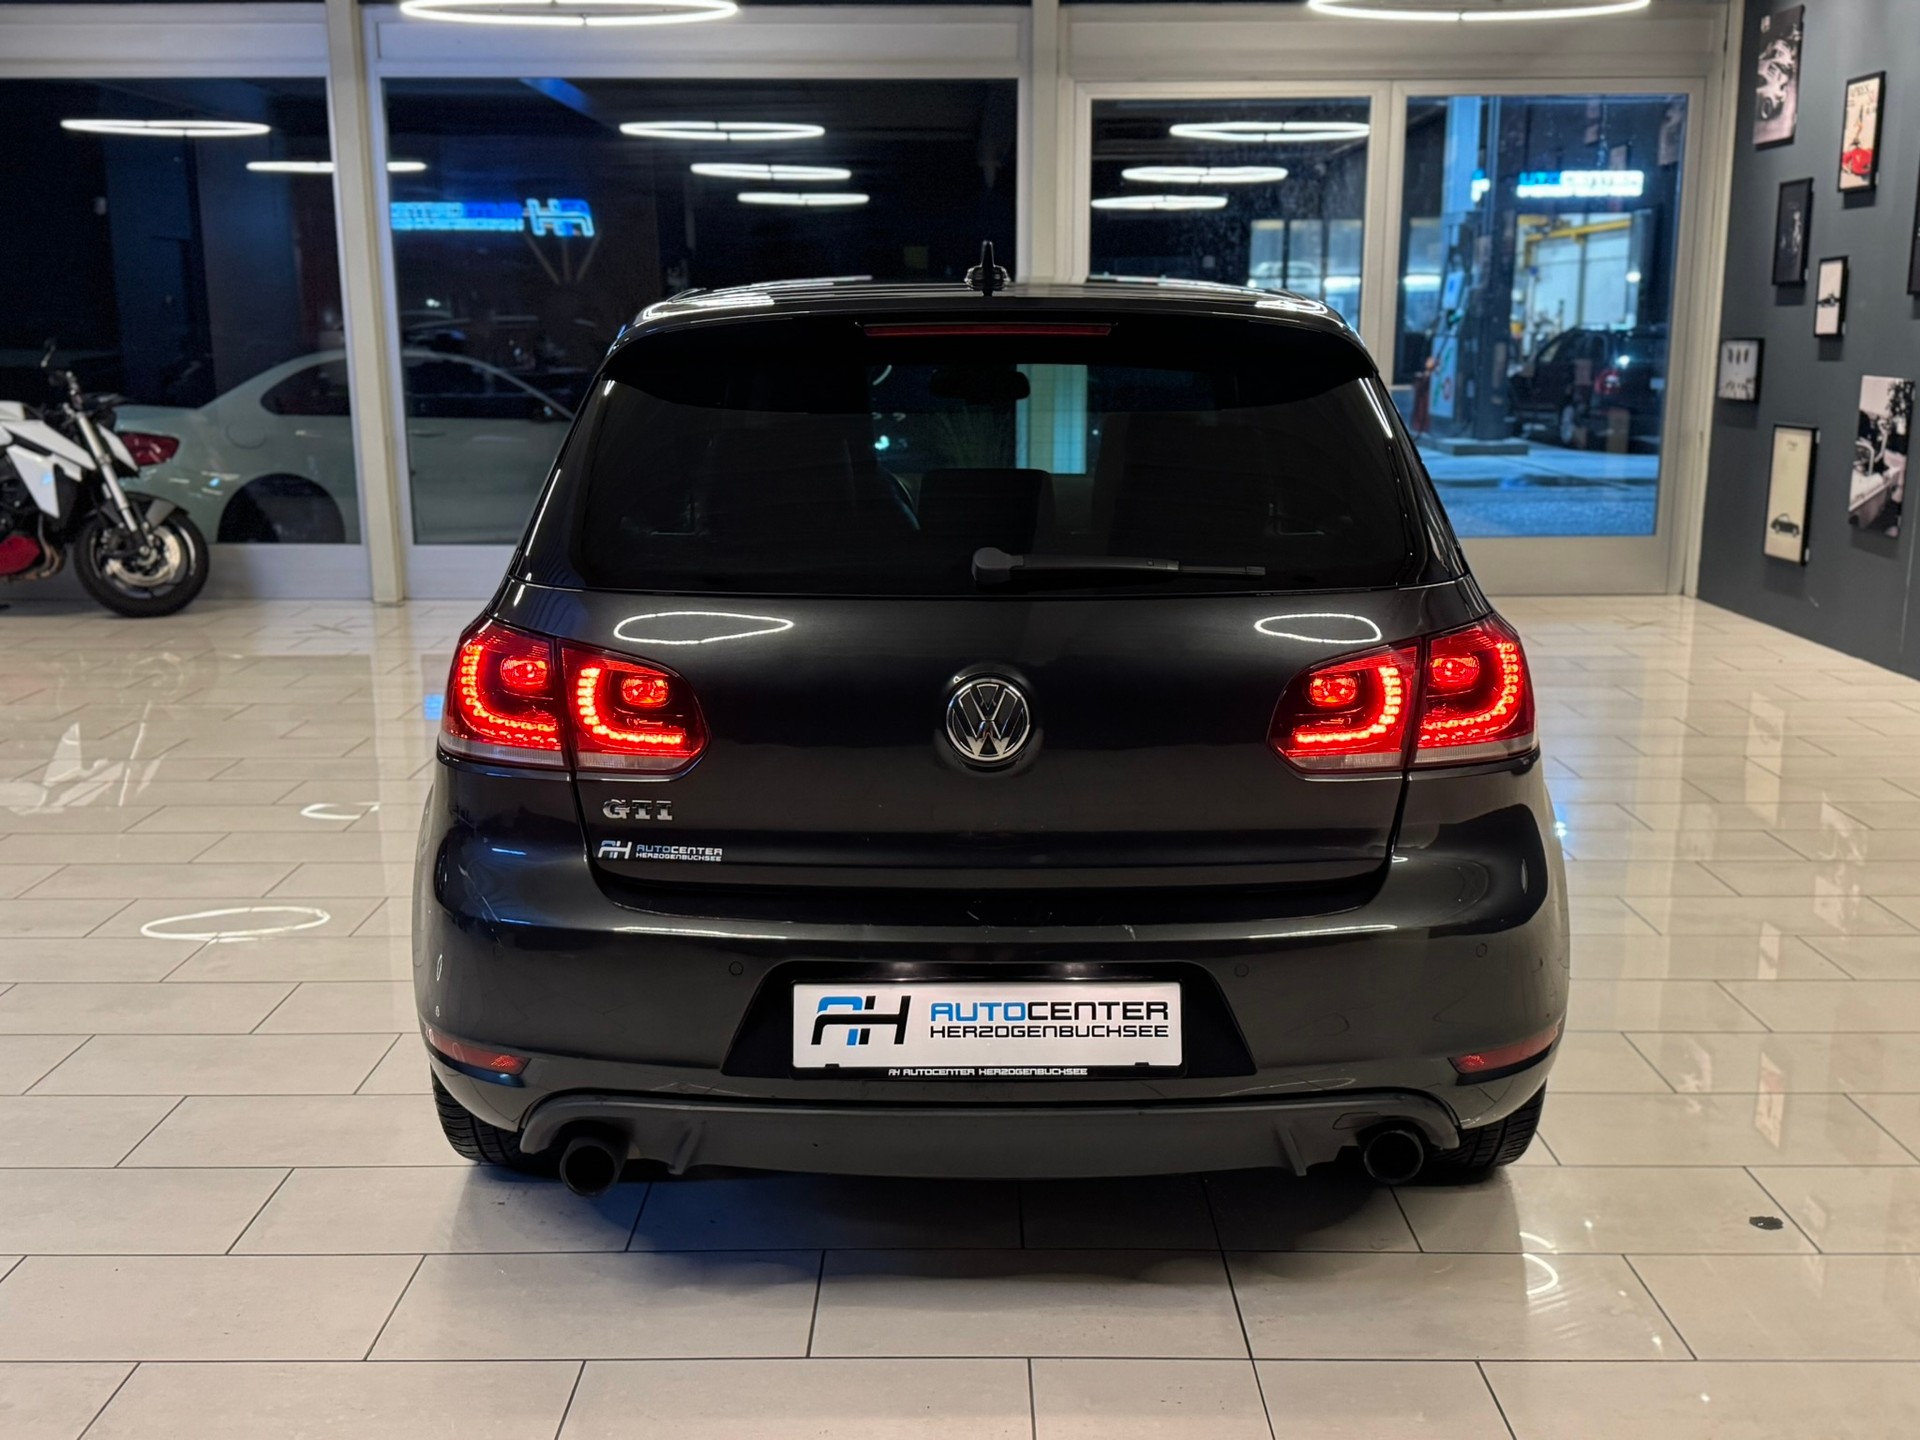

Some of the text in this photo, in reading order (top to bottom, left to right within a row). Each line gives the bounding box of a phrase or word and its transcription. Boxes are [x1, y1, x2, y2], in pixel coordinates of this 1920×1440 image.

[949, 681, 1026, 760] VW
[602, 799, 673, 820] GTI
[598, 840, 632, 859] AH
[635, 852, 722, 862] HERZOGENBUCHSEE
[636, 844, 723, 855] AUTOCENTER
[810, 995, 912, 1046] AH
[930, 1001, 1169, 1022] AUTOCENTER
[929, 1024, 1169, 1039] HERZOGENBUCHSEE
[903, 1068, 975, 1076] AUTOCENTER
[979, 1068, 1088, 1076] HERZOGENBUCHSEE
